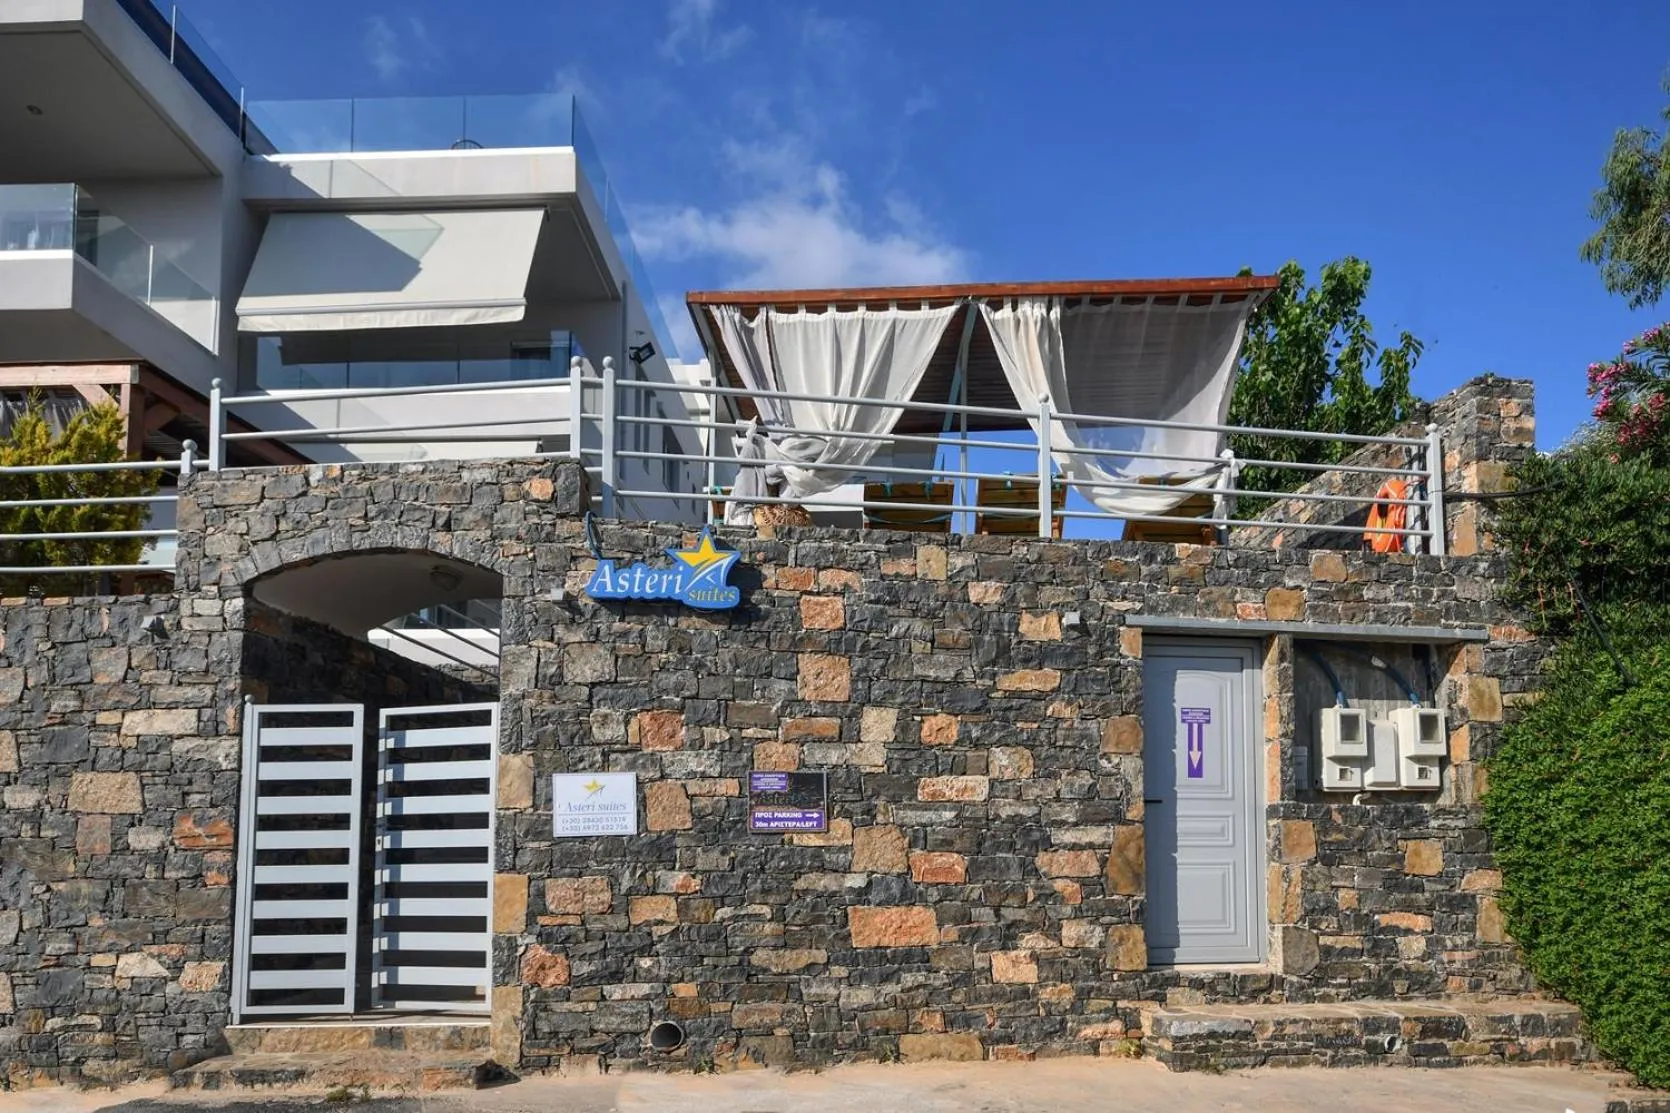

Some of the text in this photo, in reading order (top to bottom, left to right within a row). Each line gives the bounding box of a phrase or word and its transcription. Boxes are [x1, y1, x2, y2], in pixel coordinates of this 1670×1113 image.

[591, 564, 684, 594] Asteri
[688, 586, 736, 602] suites
[563, 801, 627, 812] Asteri suites
